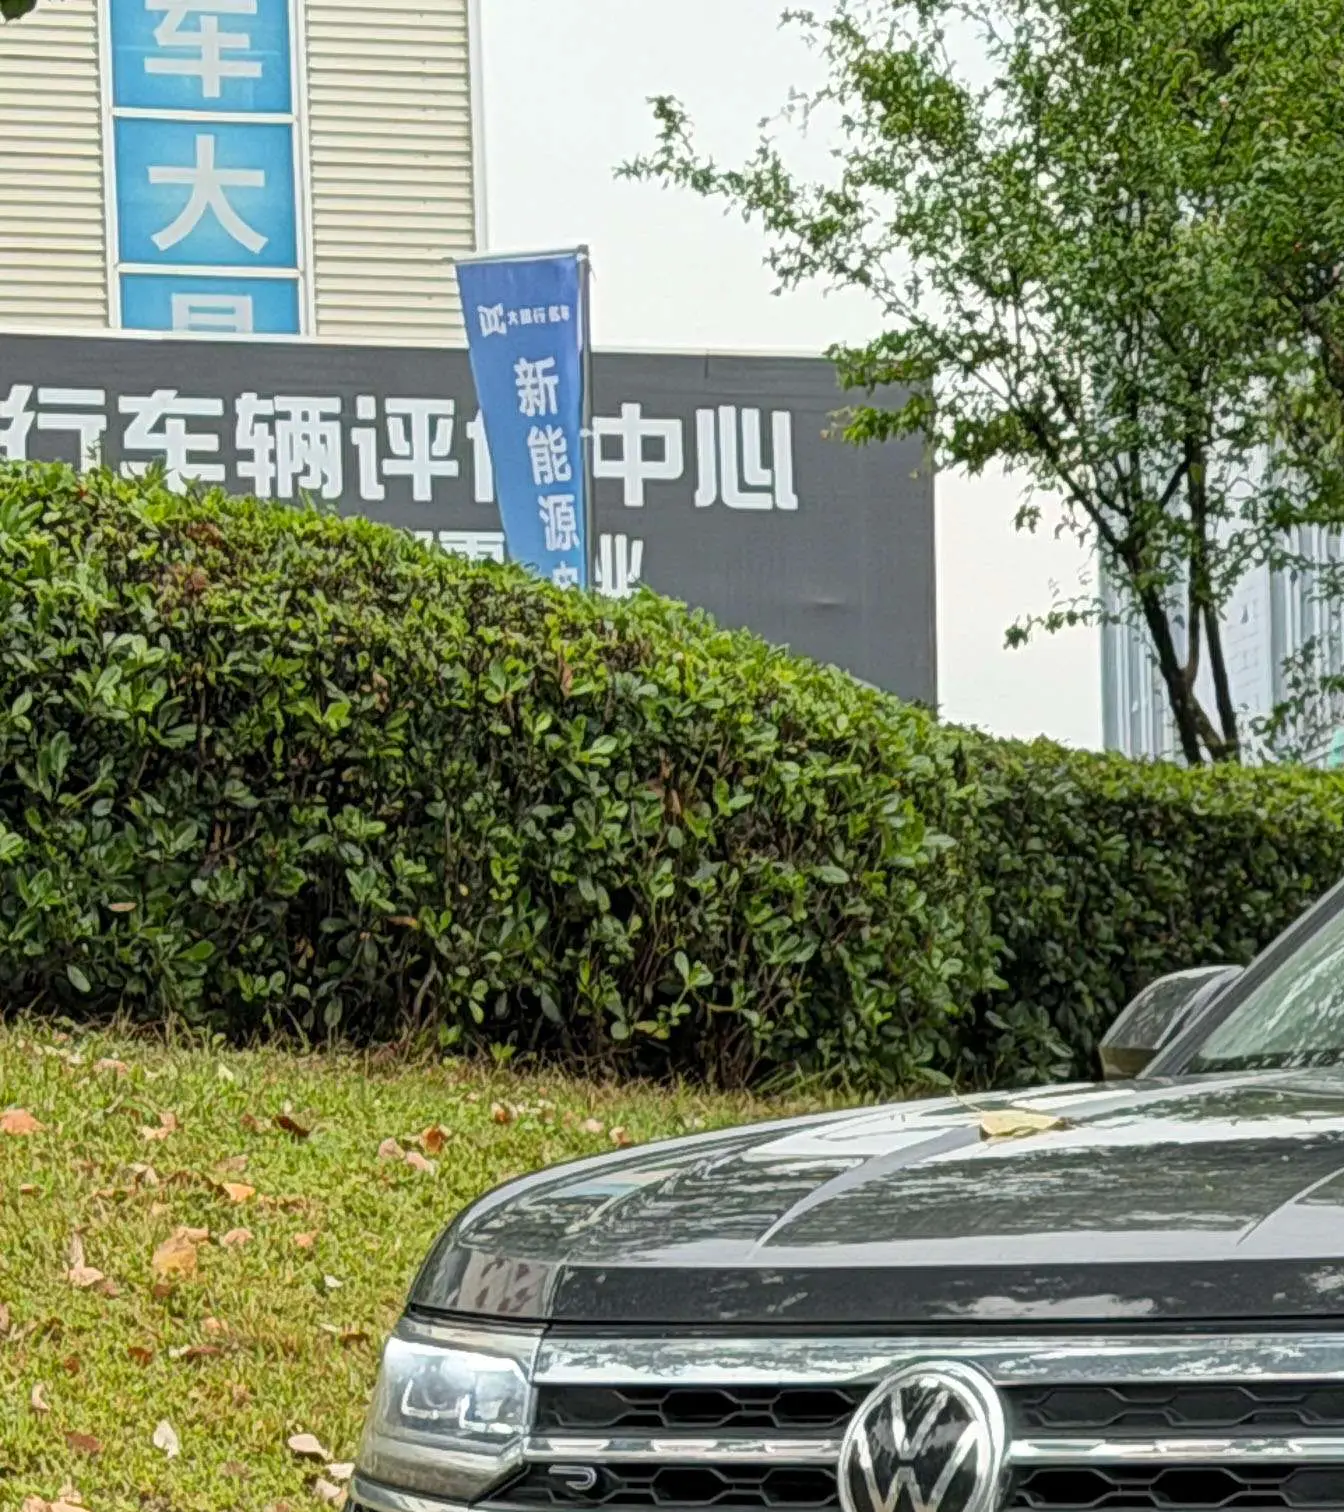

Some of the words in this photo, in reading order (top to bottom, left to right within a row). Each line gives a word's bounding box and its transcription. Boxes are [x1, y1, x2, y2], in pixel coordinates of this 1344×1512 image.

[0, 384, 799, 511] 行车辆评中心
